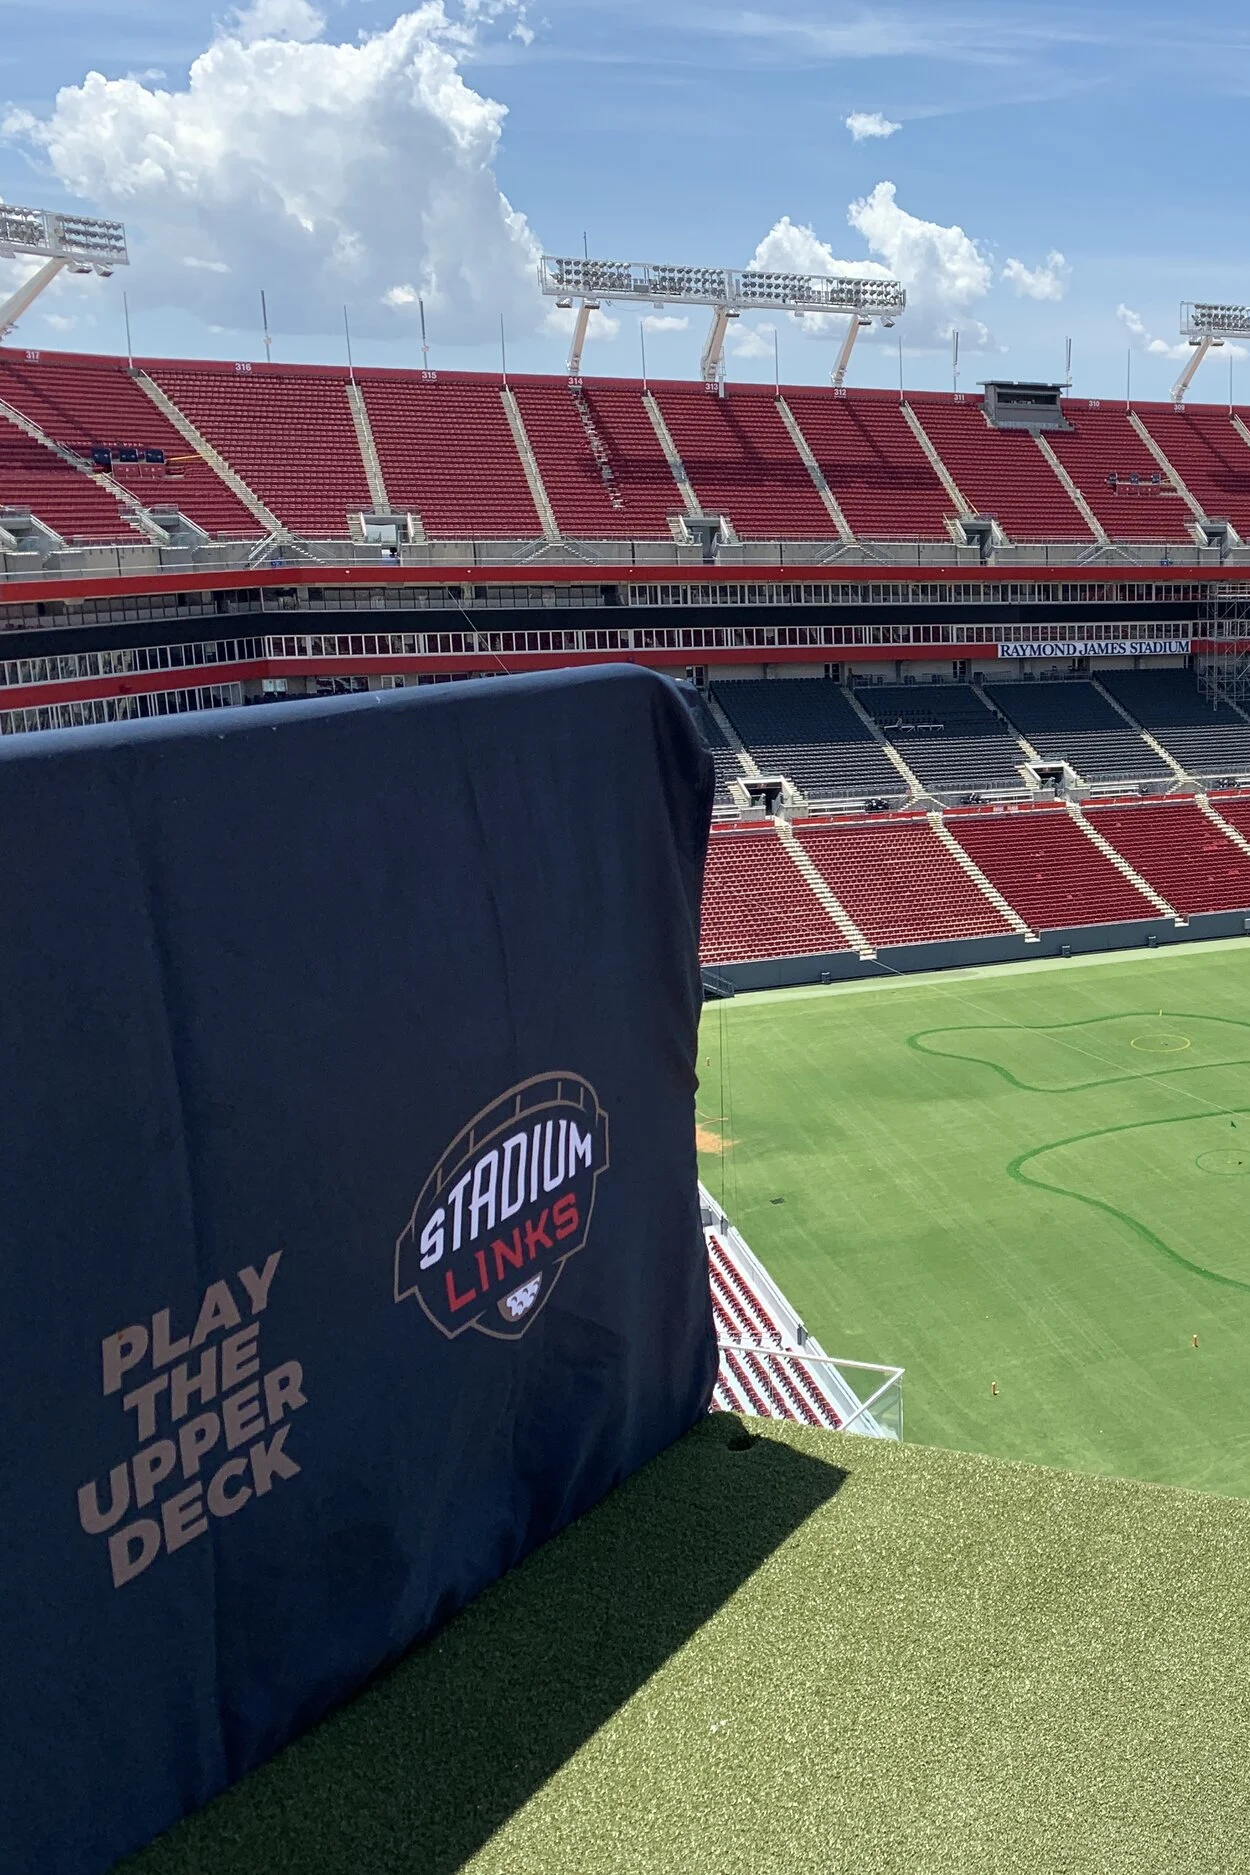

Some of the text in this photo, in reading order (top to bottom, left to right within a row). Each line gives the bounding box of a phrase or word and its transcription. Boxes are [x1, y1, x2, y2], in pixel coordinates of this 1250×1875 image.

[25, 350, 40, 359] 317
[235, 362, 252, 371] 316
[421, 371, 437, 379] 315
[568, 377, 583, 385] 314
[705, 383, 718, 391] 313
[834, 388, 847, 396] 312
[1000, 640, 1190, 657] RAYMOND JAMES STADIUM
[419, 1119, 592, 1270] STADIUM
[445, 1192, 580, 1312] LINKS
[101, 1249, 283, 1396] PLAY
[123, 1320, 260, 1442] THE
[77, 1360, 308, 1535] UPPER
[107, 1423, 302, 1589] DECK
